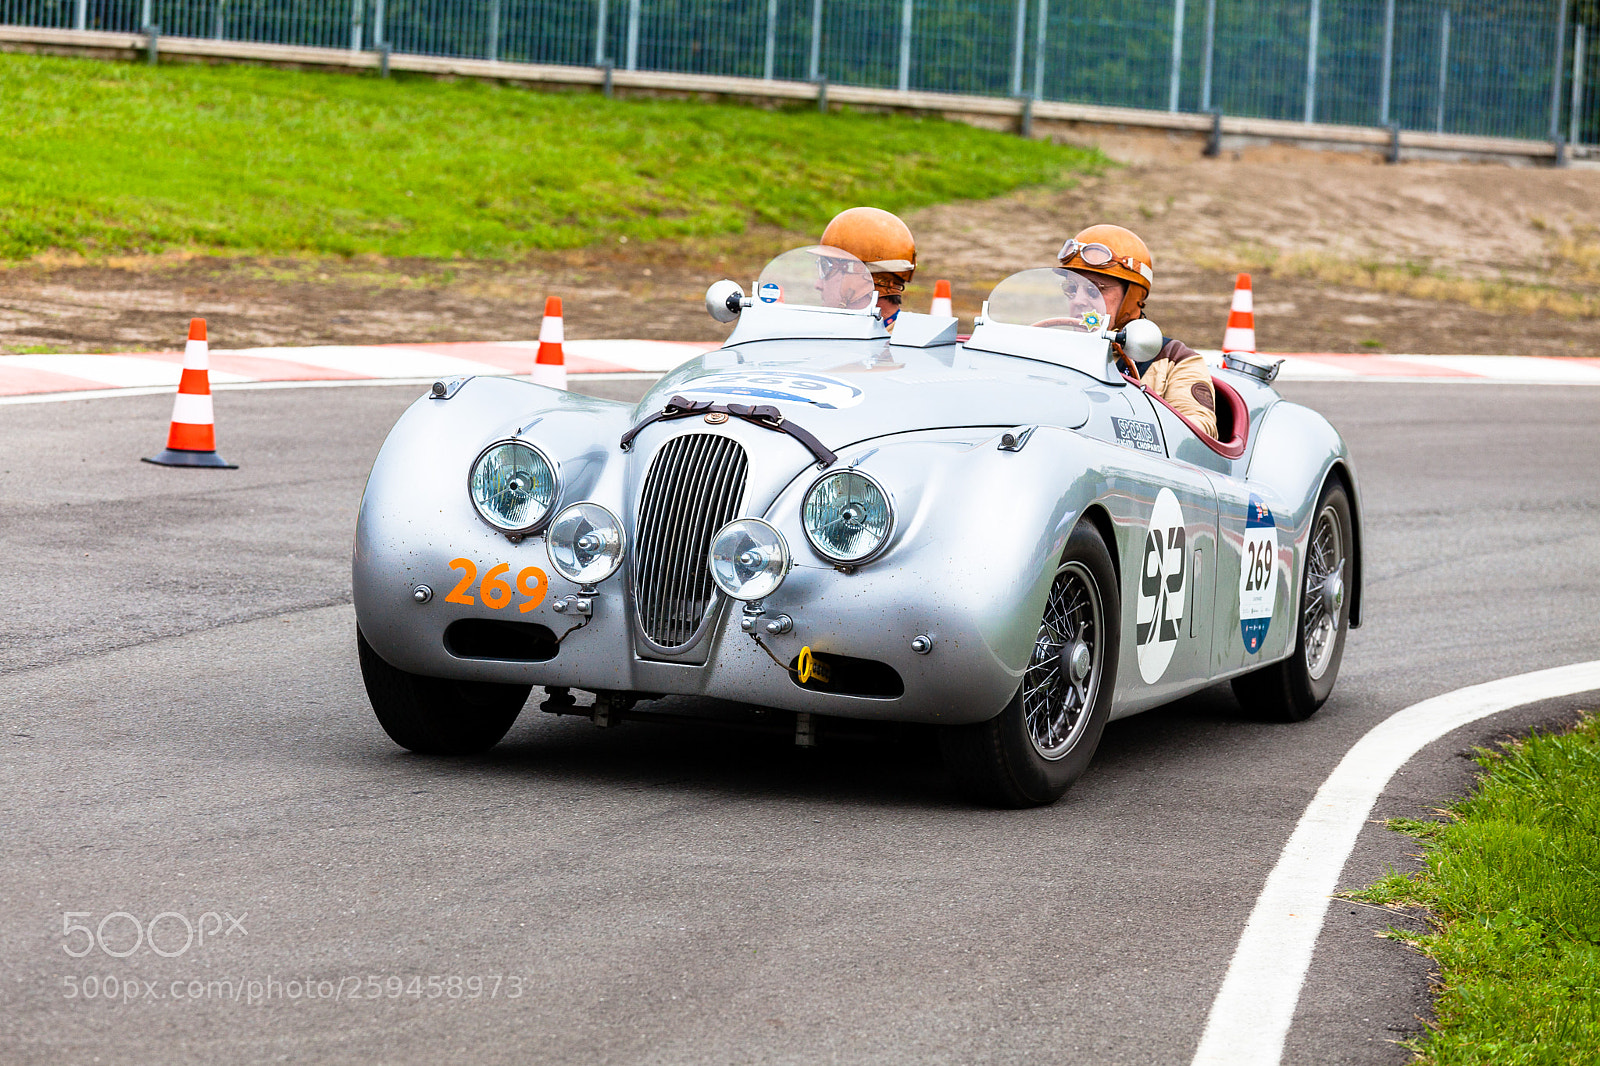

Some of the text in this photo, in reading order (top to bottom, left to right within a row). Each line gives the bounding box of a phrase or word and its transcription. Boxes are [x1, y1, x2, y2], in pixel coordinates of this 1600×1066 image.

[706, 375, 828, 391] 269
[1117, 418, 1154, 444] SPORTS
[1245, 539, 1273, 592] 269
[444, 557, 549, 614] 269
